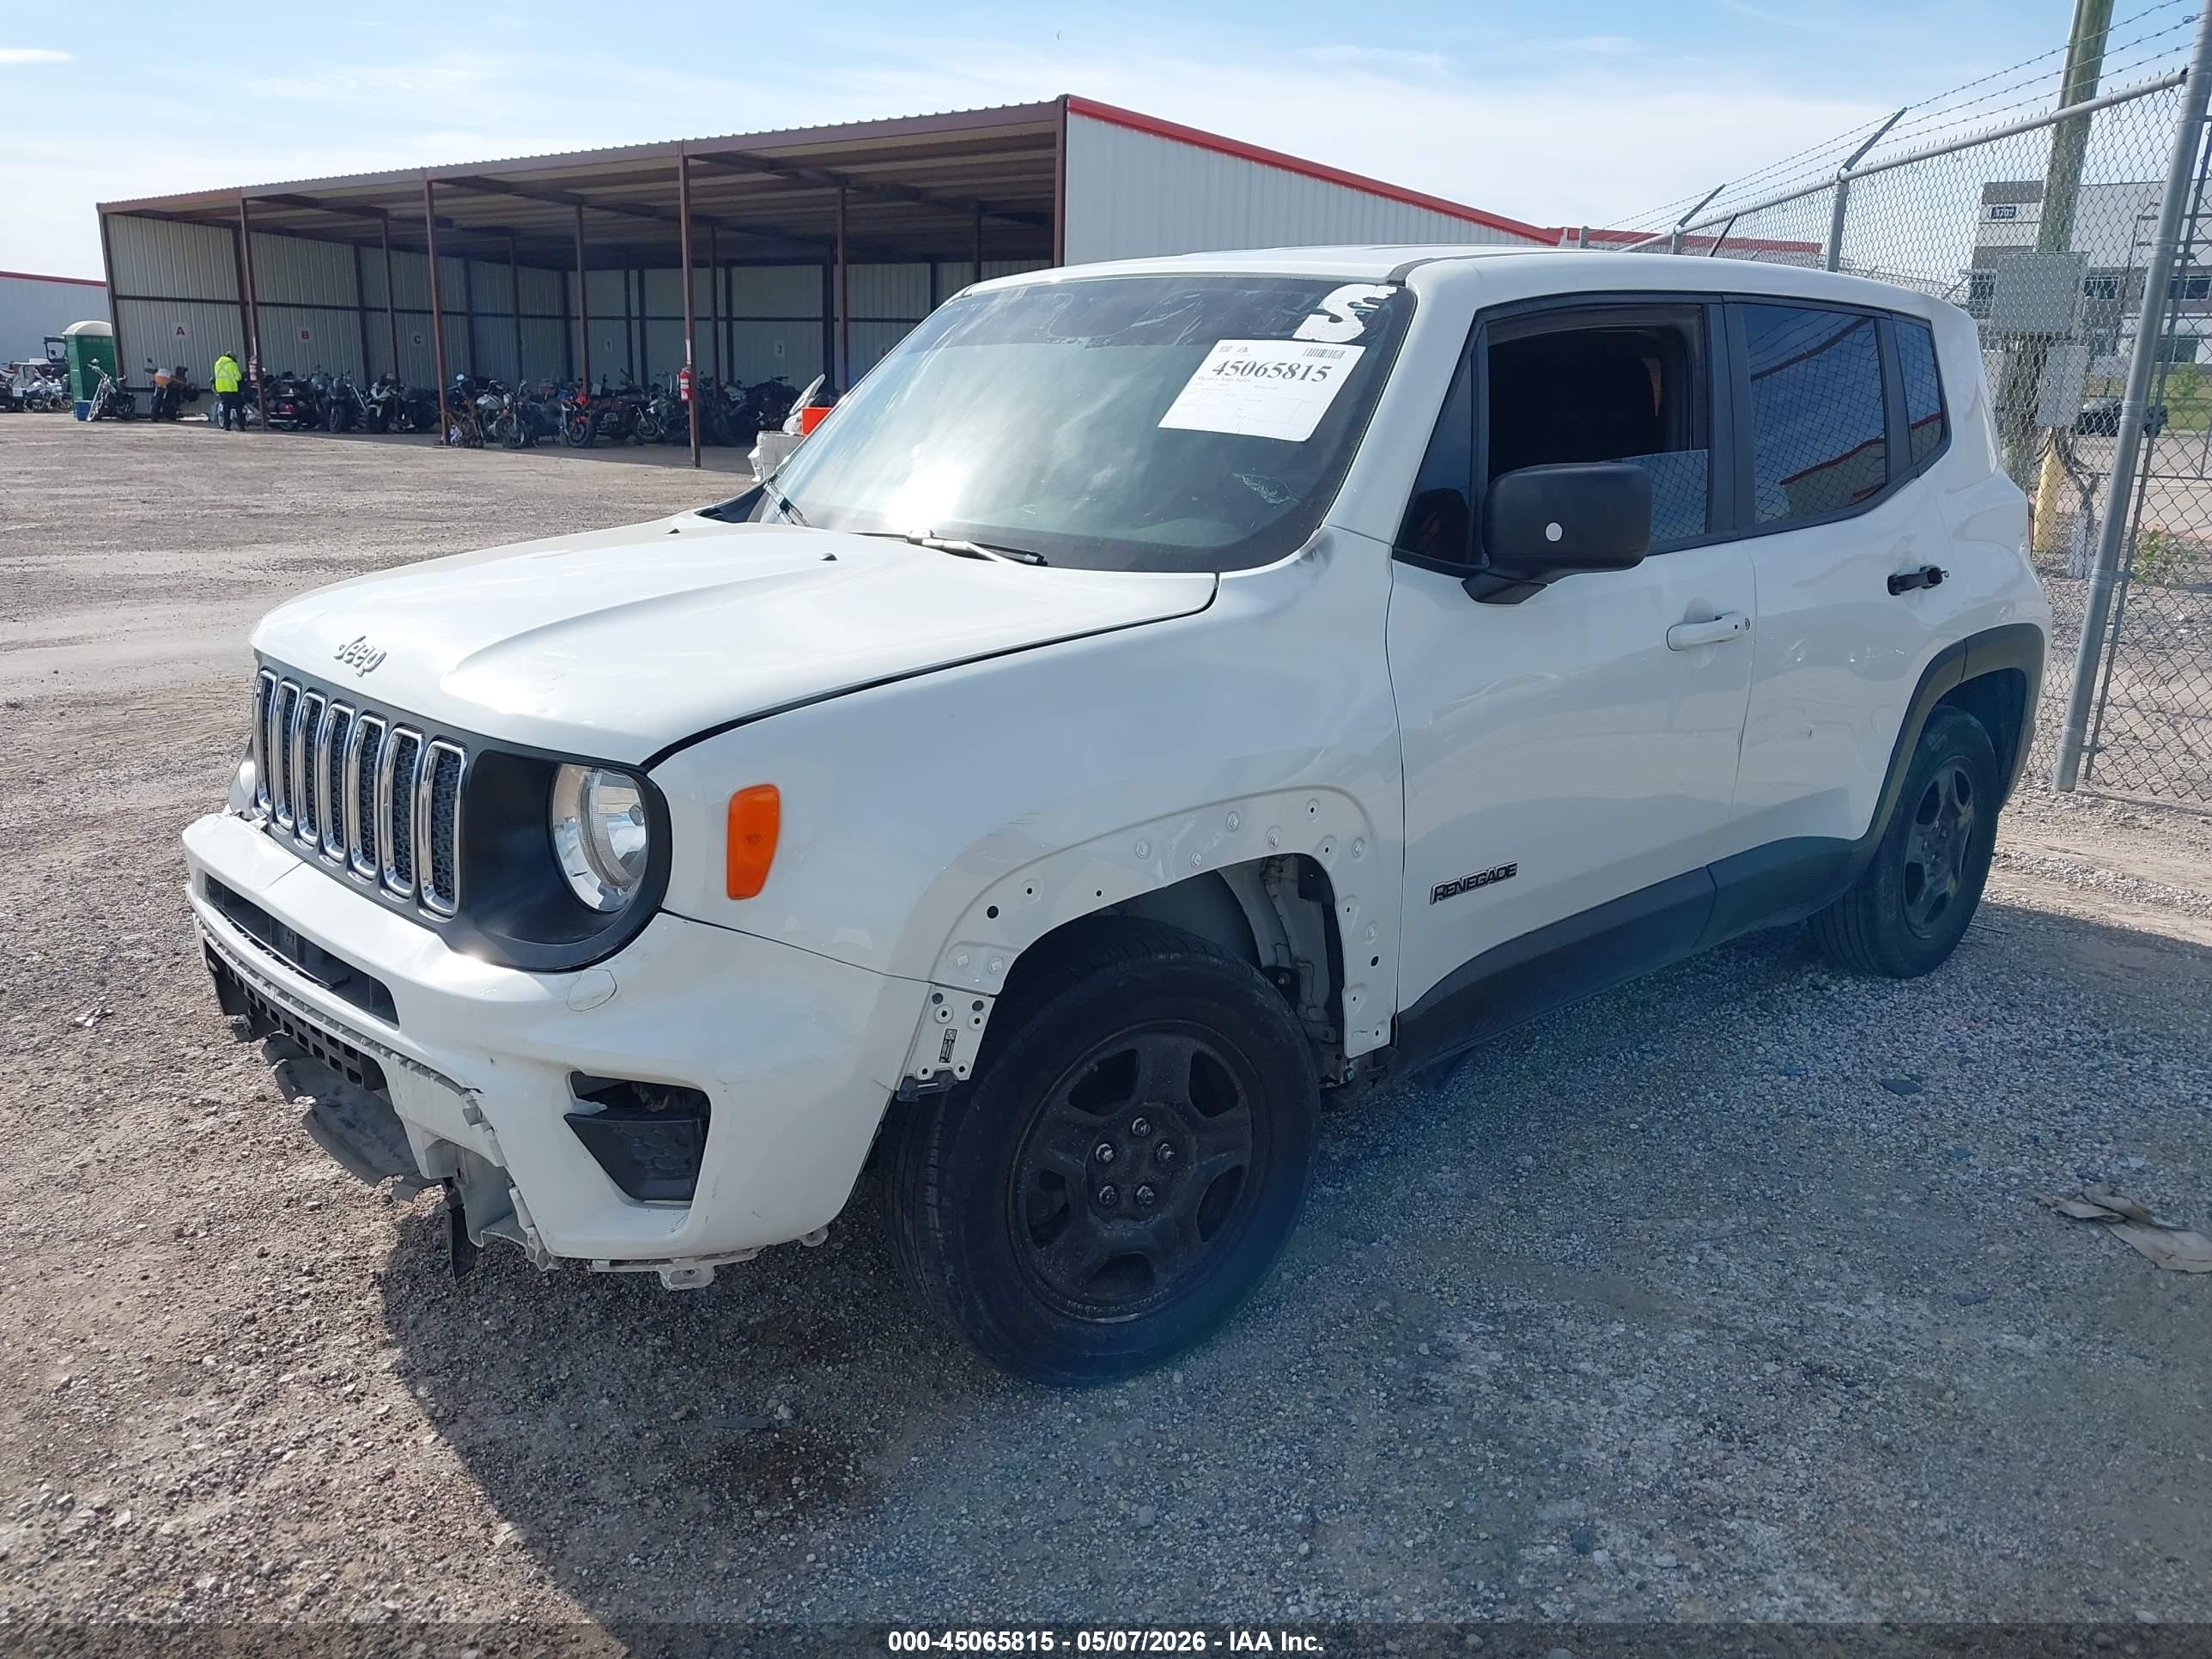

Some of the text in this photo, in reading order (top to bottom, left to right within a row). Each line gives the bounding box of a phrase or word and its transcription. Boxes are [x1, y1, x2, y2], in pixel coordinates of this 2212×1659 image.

[176, 326, 185, 336] A
[301, 330, 310, 340] B
[414, 335, 422, 344] C
[1212, 360, 1334, 382] 45065815
[333, 635, 386, 677] Jeep
[1430, 860, 1518, 905] RENEGADE
